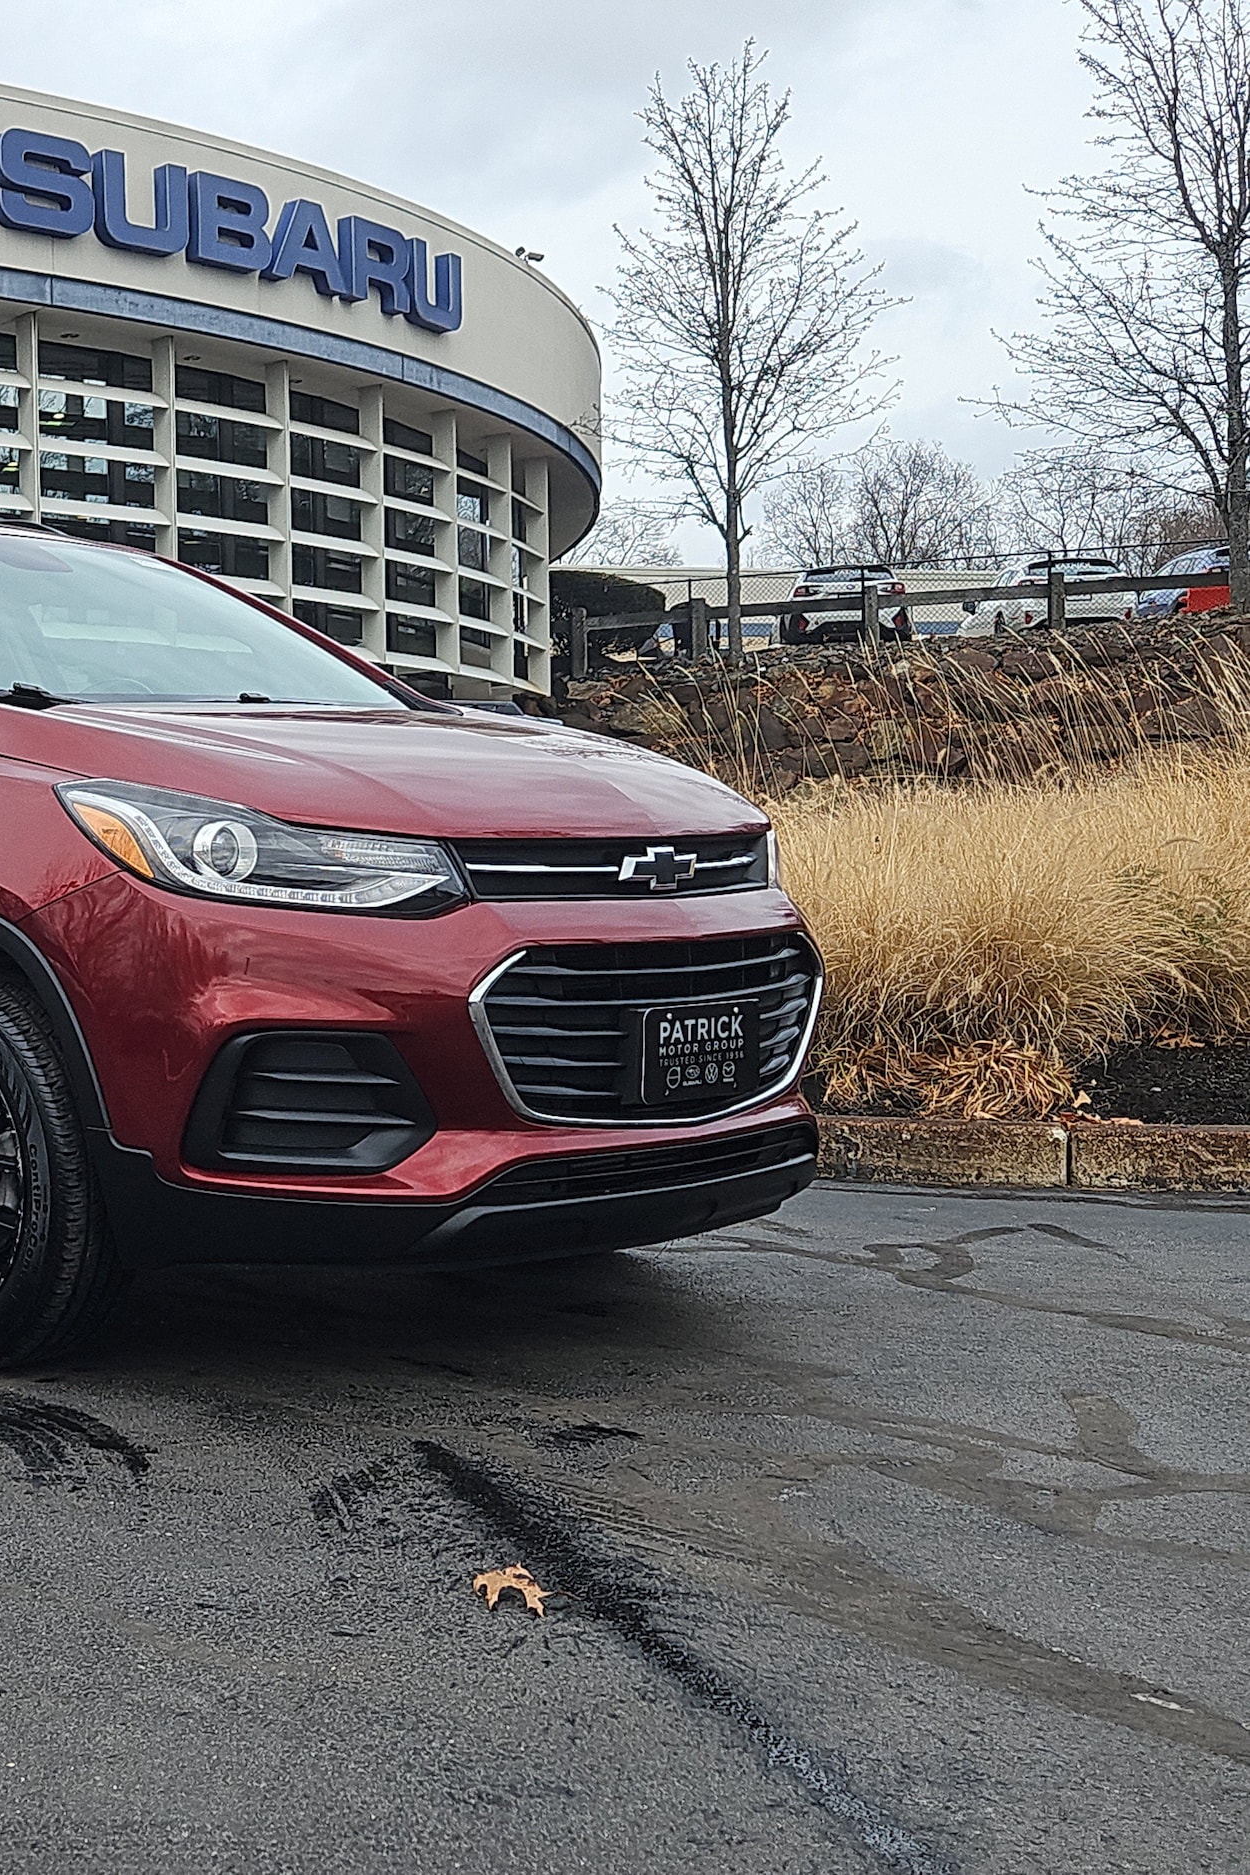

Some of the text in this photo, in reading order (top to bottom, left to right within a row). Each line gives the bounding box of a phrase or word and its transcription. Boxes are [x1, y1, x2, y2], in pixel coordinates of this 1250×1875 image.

[660, 1015, 744, 1044] PATRICK
[659, 1039, 744, 1056] MOTOR GROUP
[659, 1056, 696, 1067] TRUSTED
[698, 1053, 722, 1063] SINCE
